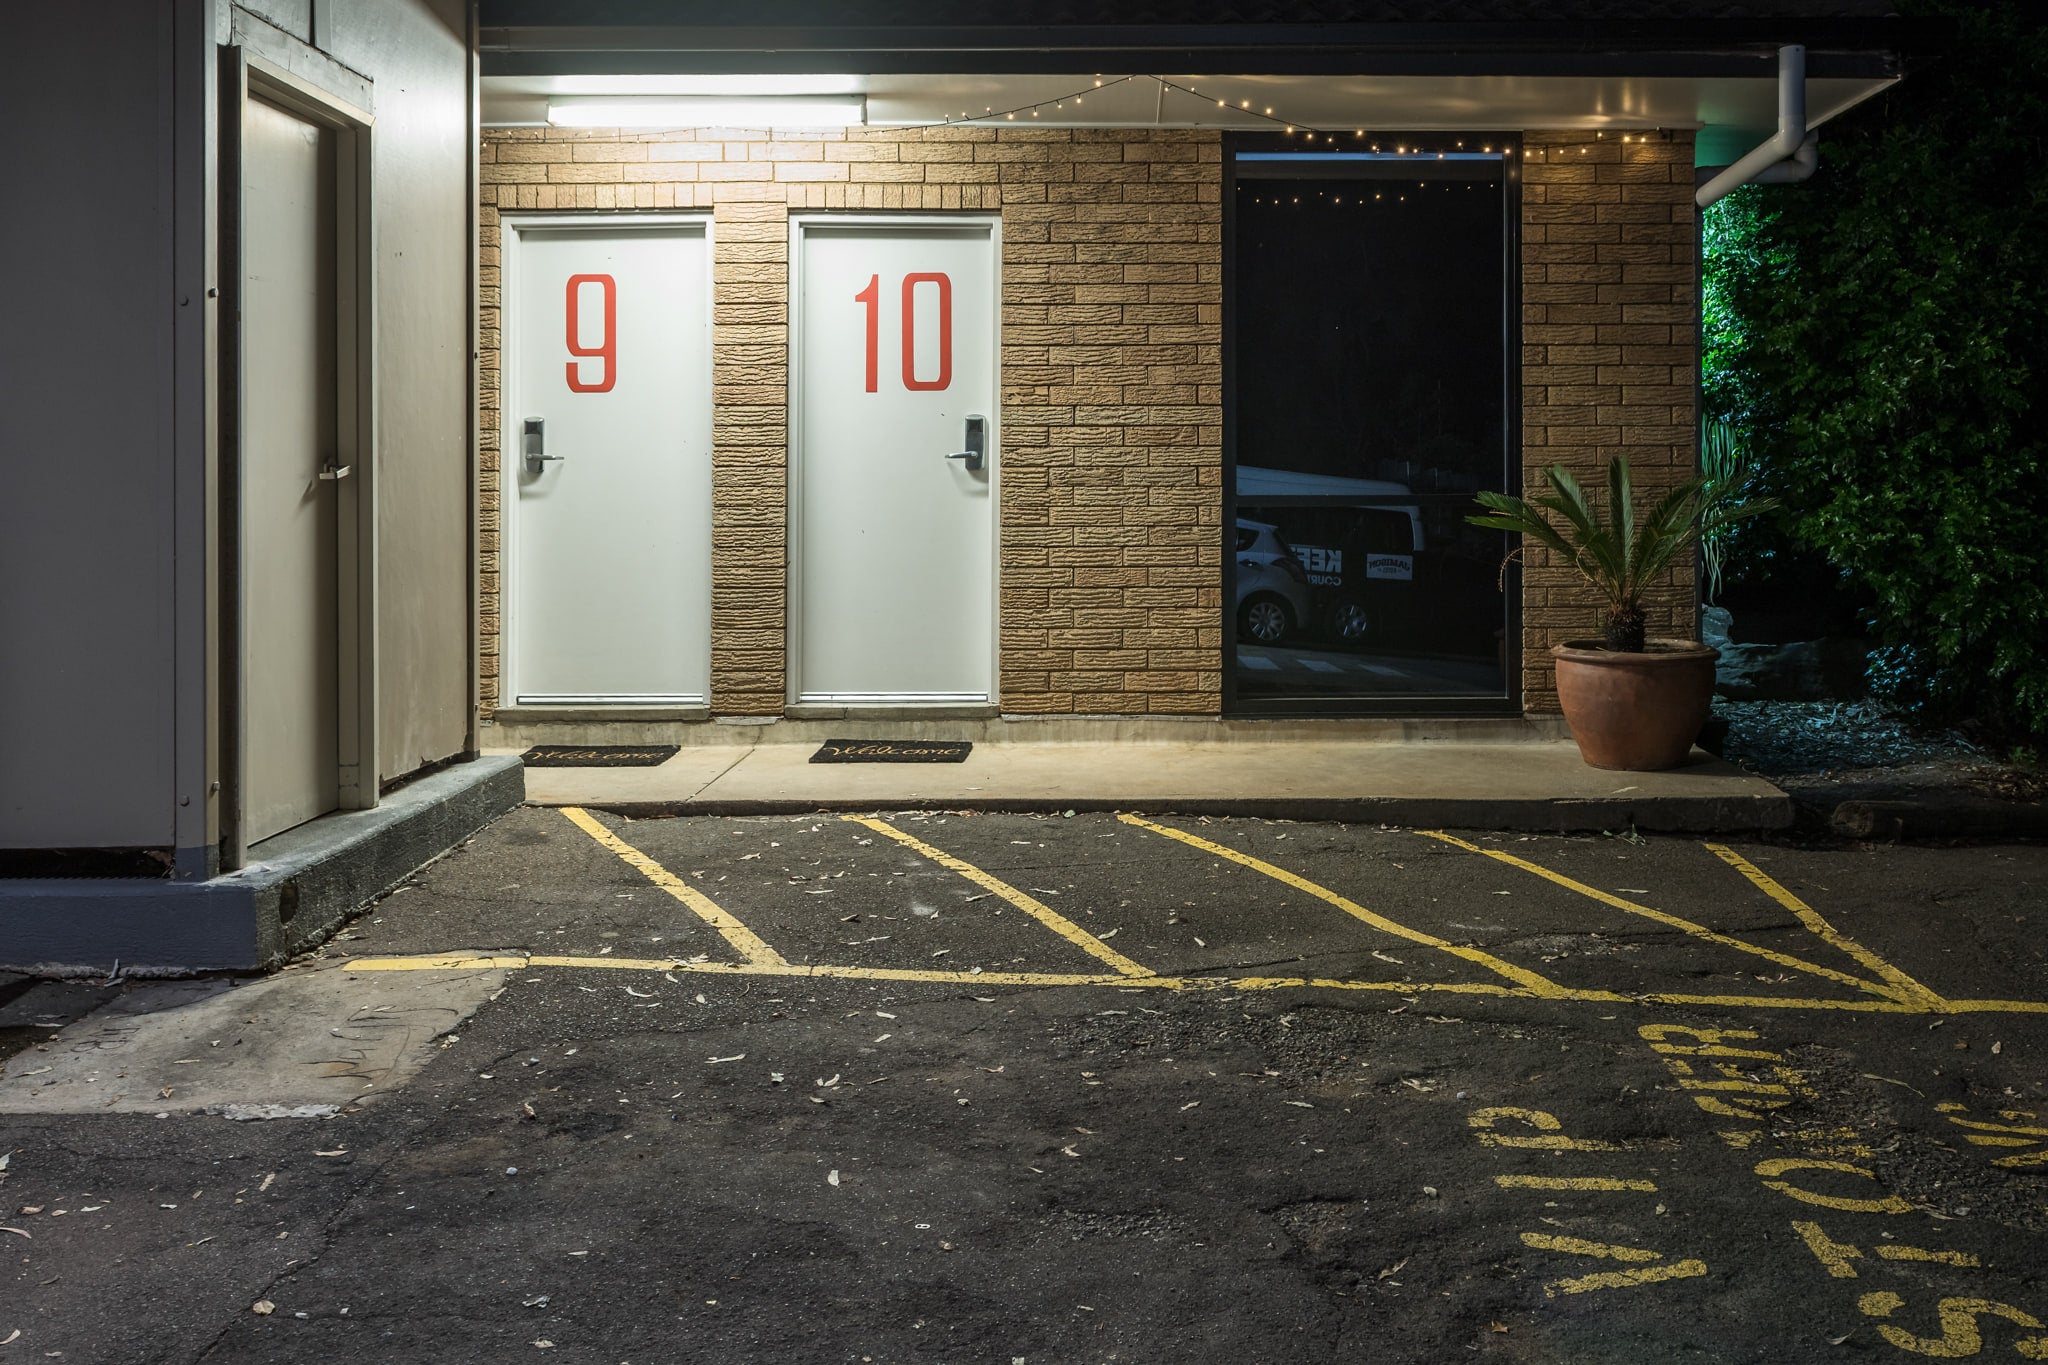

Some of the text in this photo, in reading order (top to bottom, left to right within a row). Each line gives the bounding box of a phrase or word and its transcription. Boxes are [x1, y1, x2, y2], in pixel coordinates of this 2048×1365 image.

[566, 274, 616, 393] 9
[854, 272, 952, 393] 10
[1467, 1106, 1707, 1298] VIP
